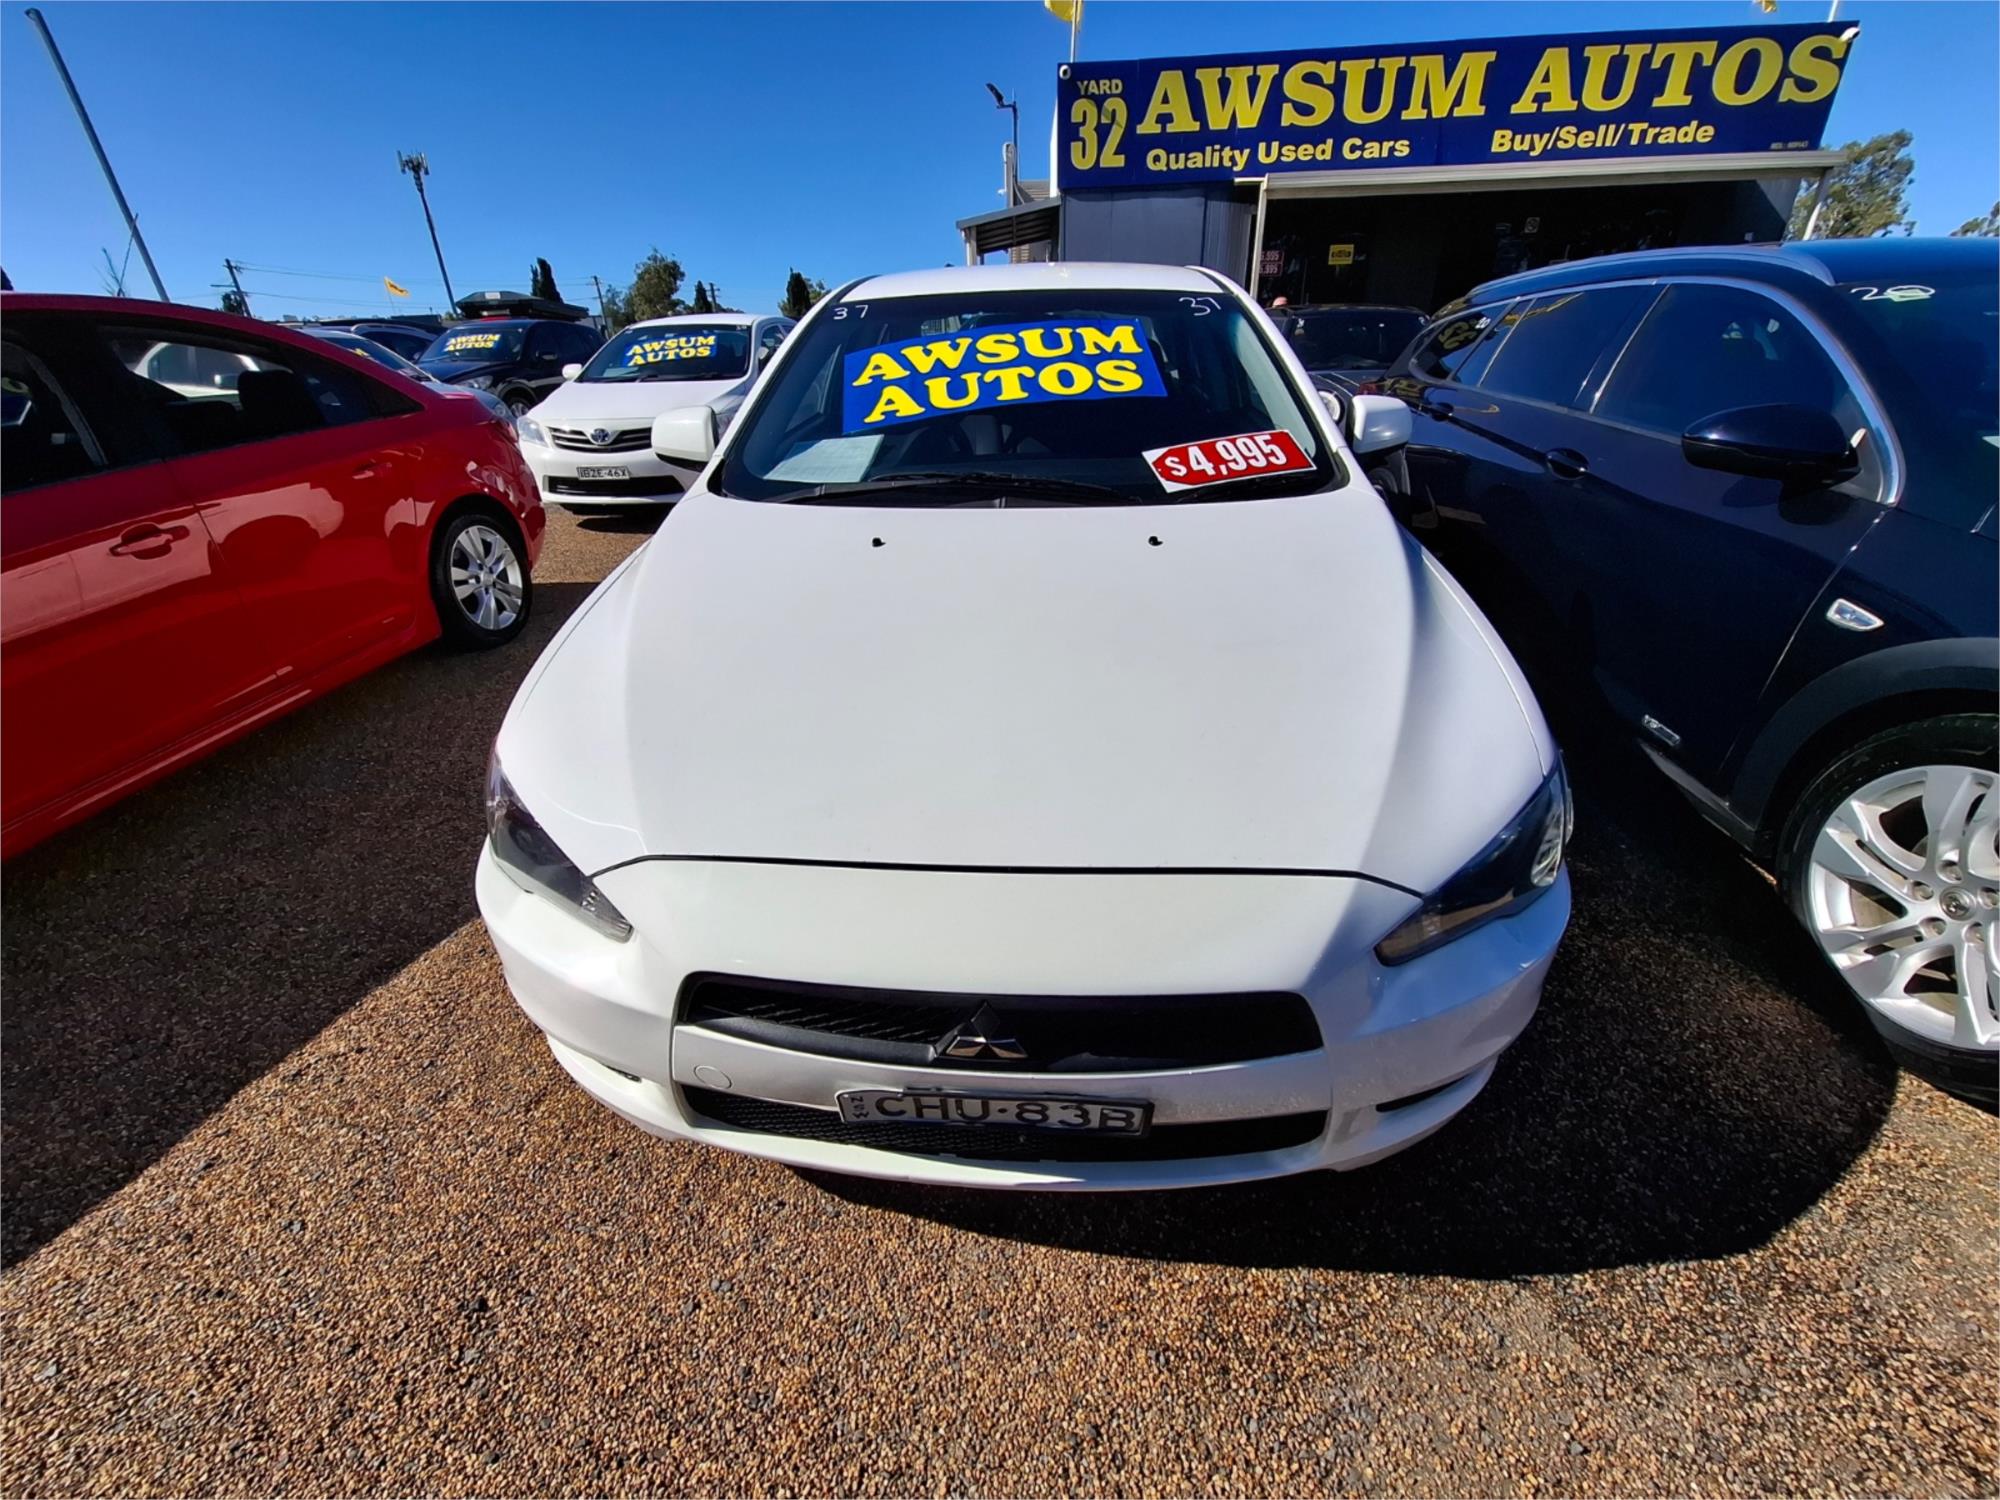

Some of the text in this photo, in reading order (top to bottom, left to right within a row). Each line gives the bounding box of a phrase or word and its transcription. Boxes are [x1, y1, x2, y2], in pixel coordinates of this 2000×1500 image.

[1077, 79, 1124, 95] YARD
[1136, 34, 1851, 134] AWSUM AUTOS
[1070, 97, 1128, 170] 32
[1491, 120, 1715, 157] Buy/Sell/Trade
[1146, 137, 1411, 172] Quality Used Cars
[443, 341, 494, 352] AUTOS
[445, 334, 501, 346] AWSUM
[625, 335, 716, 356] AWSUM
[627, 346, 711, 366] AUTOS
[852, 325, 1144, 386] AWSUM
[863, 360, 1144, 423] AUTOS
[1165, 434, 1287, 477] $4,995
